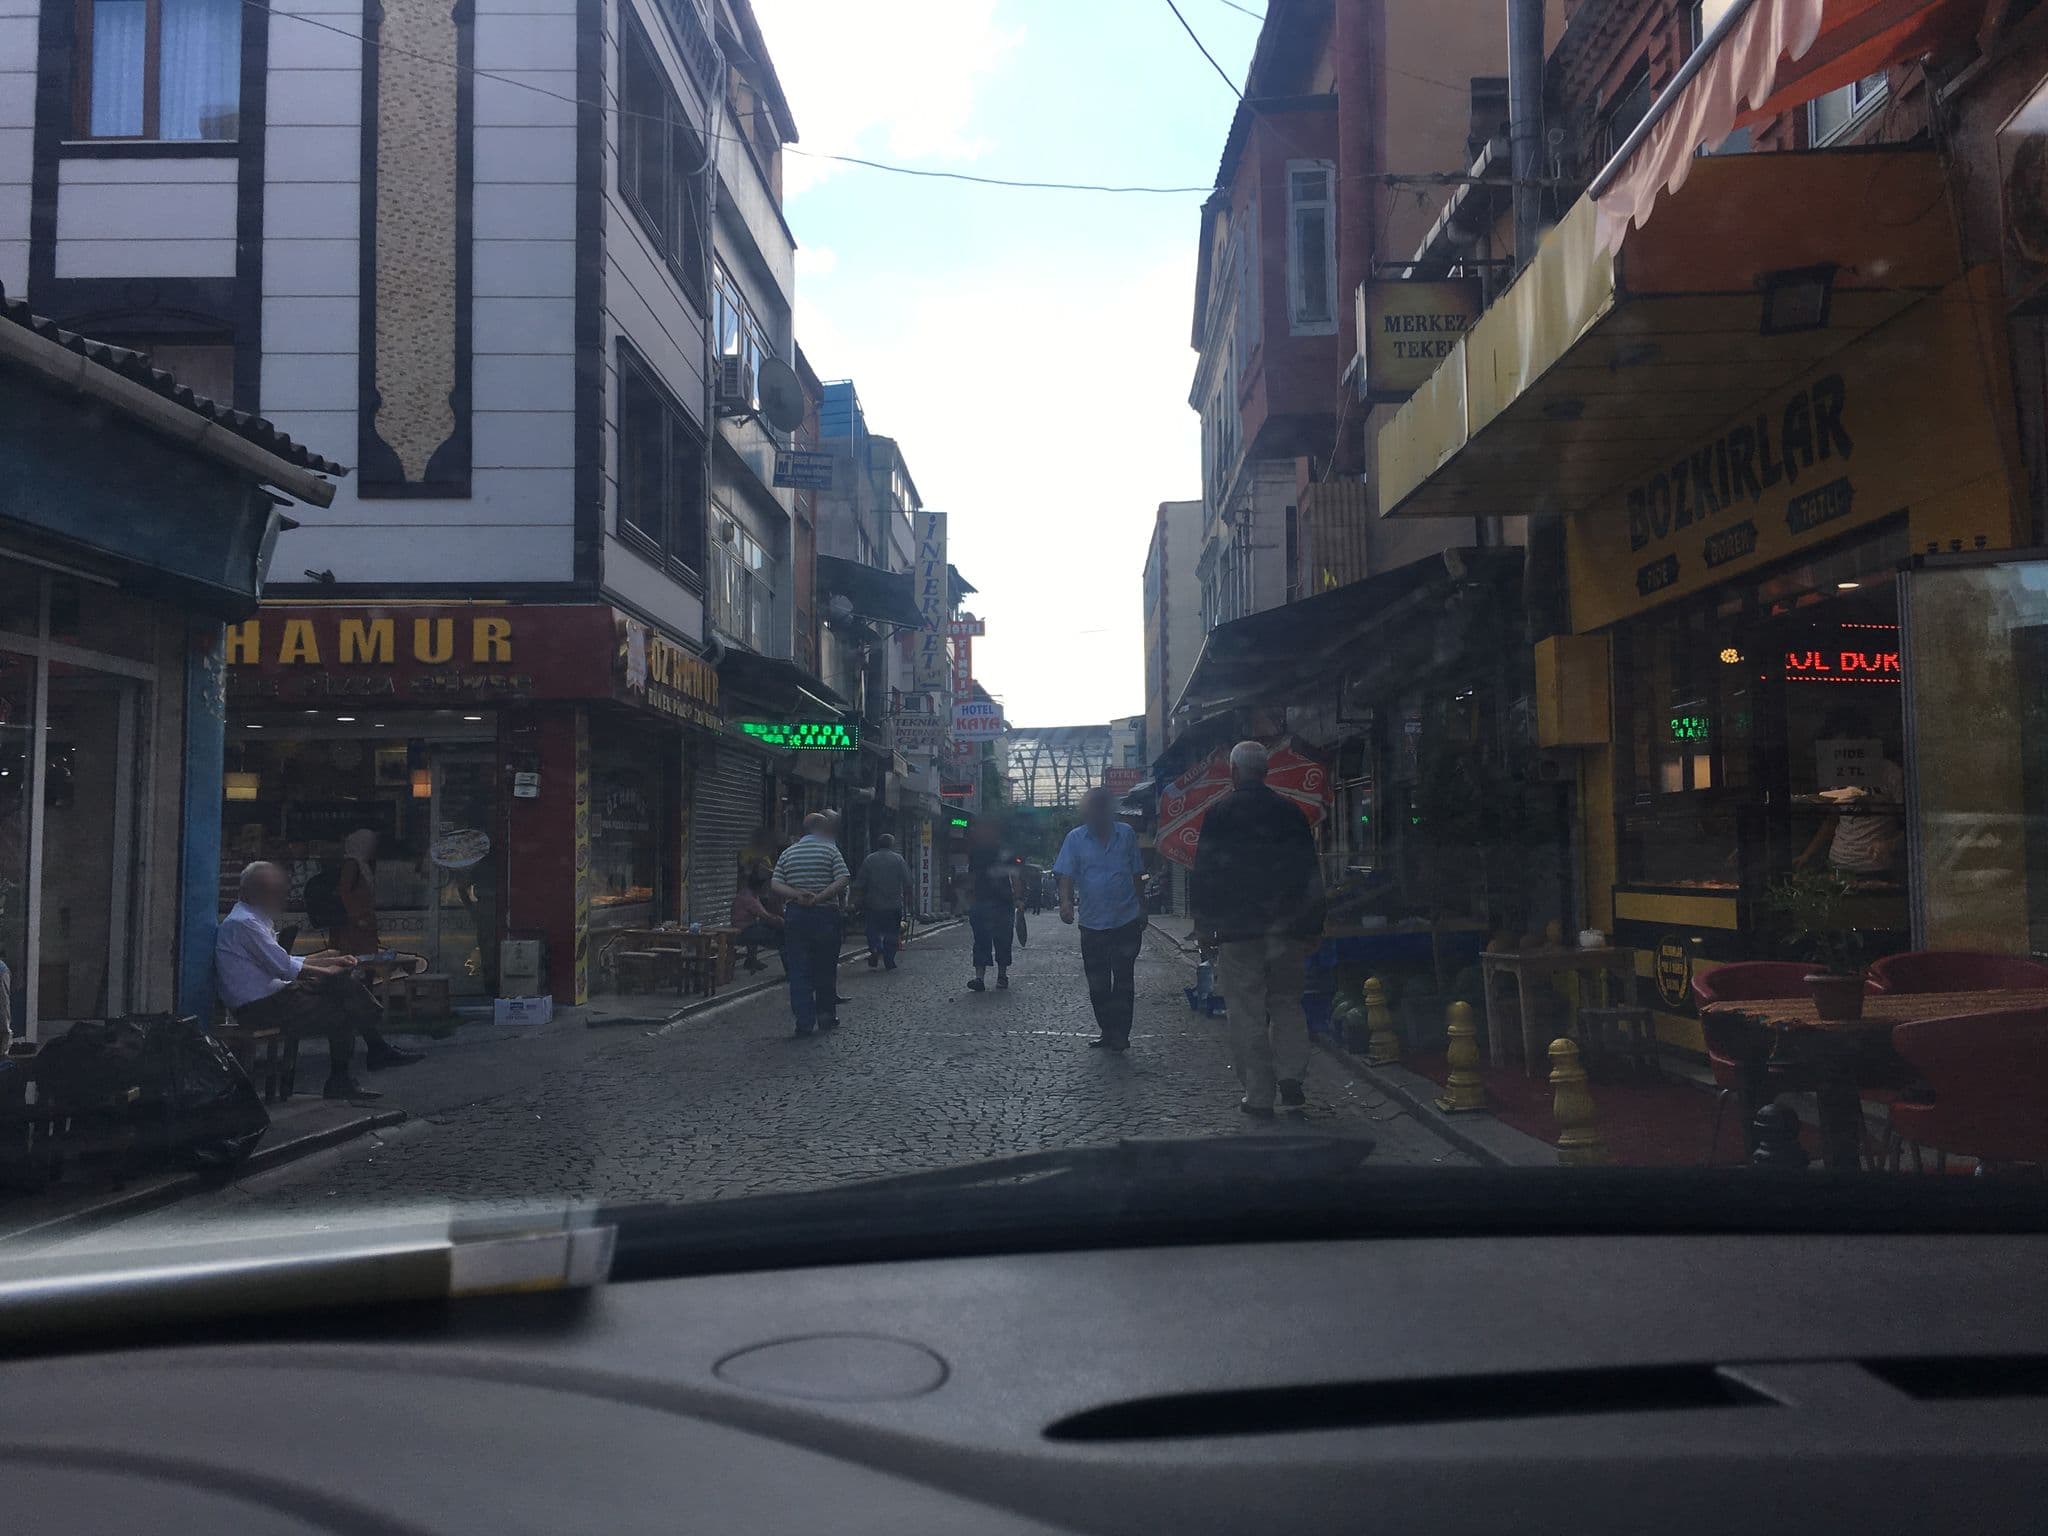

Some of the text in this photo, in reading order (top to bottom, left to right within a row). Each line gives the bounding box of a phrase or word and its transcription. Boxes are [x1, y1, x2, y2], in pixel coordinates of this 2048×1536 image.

[1384, 314, 1469, 332] MERKEZ
[1628, 373, 1853, 552] BOZKIRLAR
[225, 617, 512, 664] HAMUR
[961, 704, 994, 716] HOTEL
[956, 716, 1000, 731] KAYA
